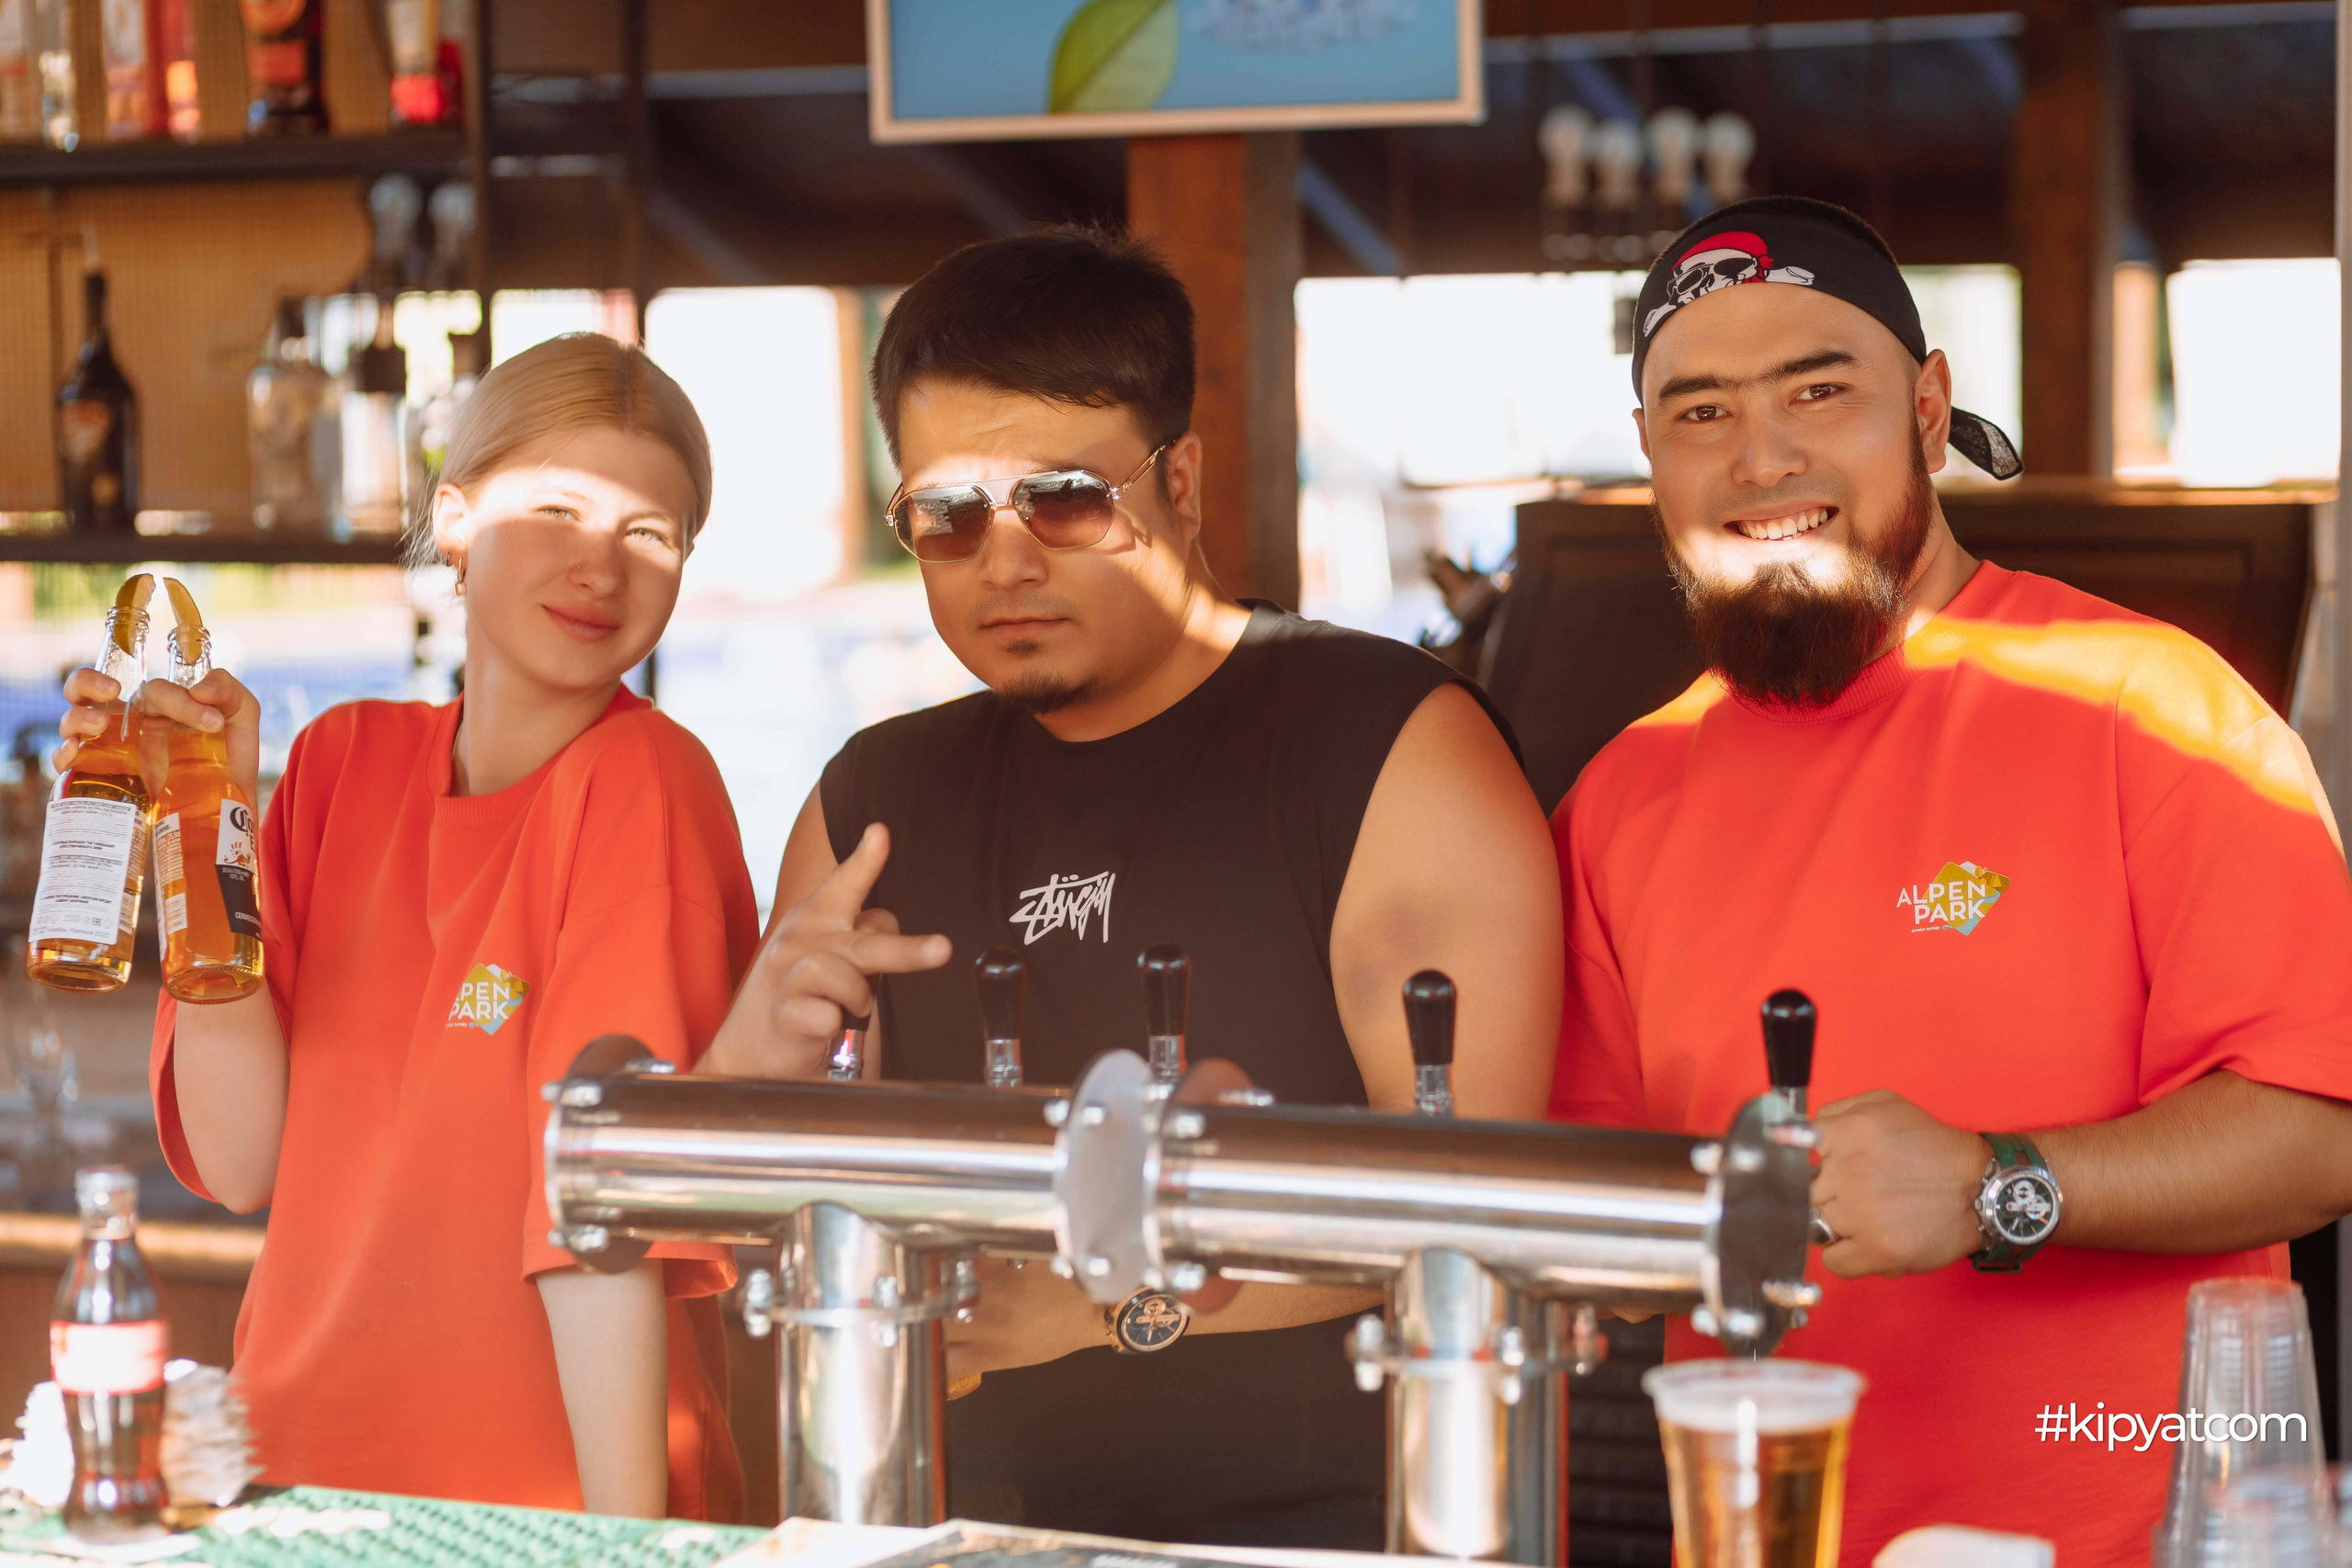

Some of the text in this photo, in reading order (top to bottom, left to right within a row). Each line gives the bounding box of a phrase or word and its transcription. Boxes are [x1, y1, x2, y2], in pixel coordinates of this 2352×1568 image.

[1895, 879, 1986, 908] ALPEN
[1914, 899, 1985, 925] PARK
[448, 1000, 509, 1020] PARK
